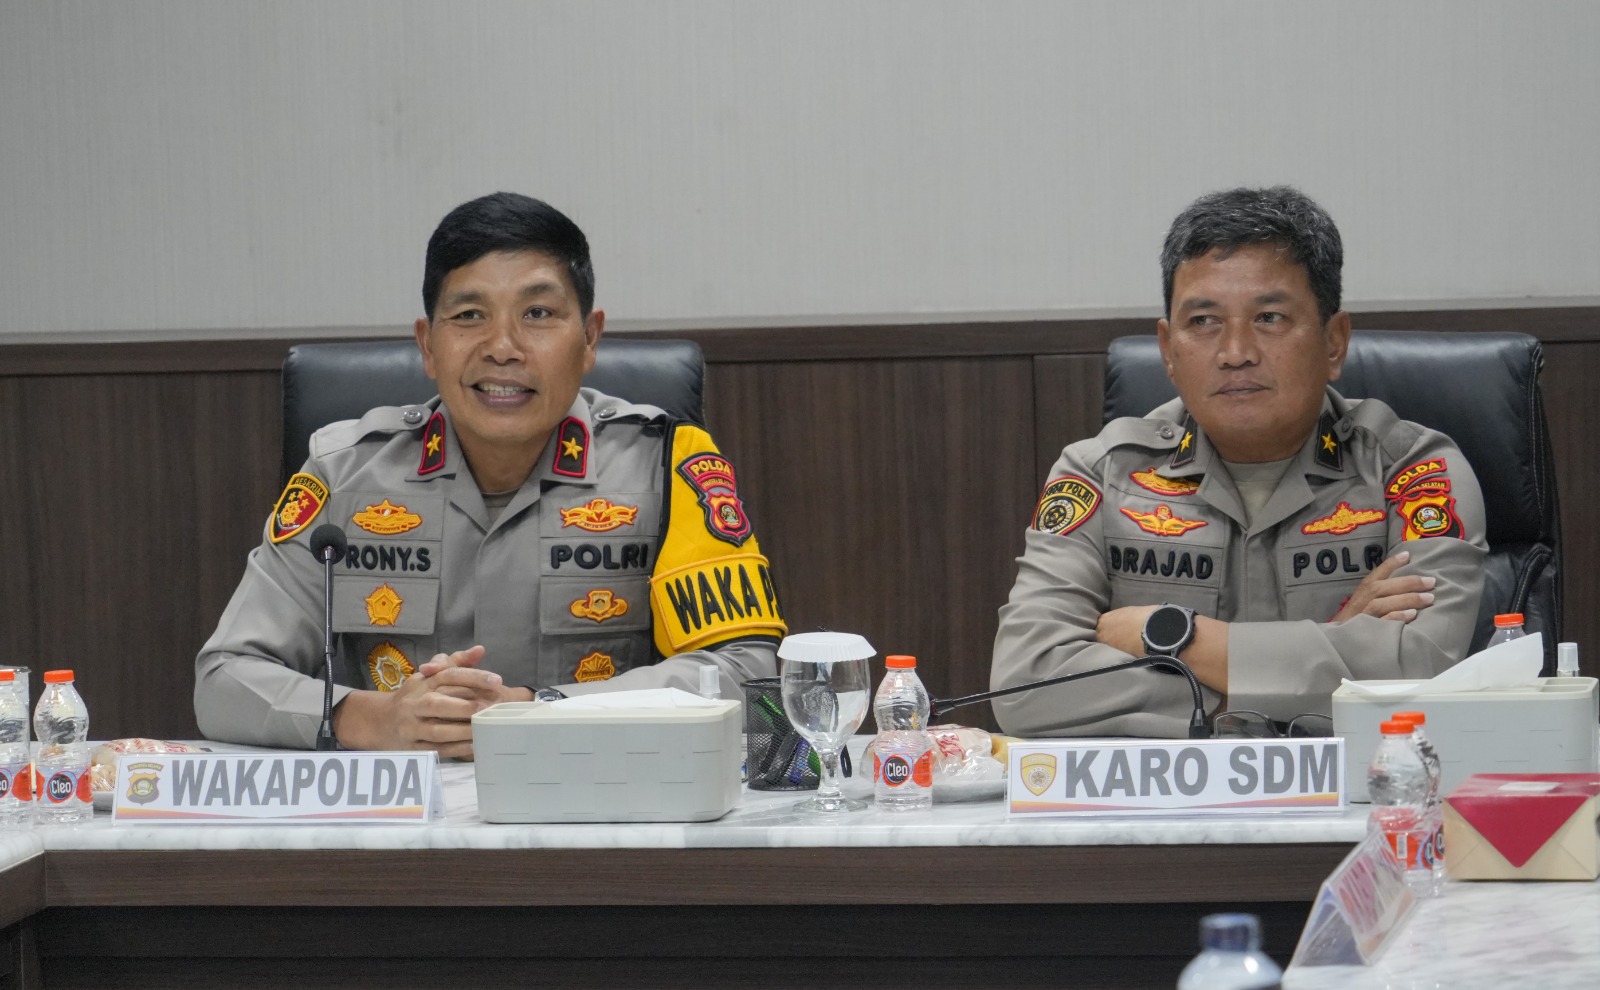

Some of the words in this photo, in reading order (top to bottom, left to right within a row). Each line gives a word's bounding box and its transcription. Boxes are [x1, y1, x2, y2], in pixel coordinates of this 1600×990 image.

[690, 459, 732, 476] POLDA
[1389, 462, 1441, 494] POLDA
[294, 477, 324, 498] RESKRIM
[346, 544, 431, 572] RONY.S
[550, 543, 648, 570] POLRI
[1110, 545, 1213, 580] DRAJAD
[1293, 544, 1384, 578] POLR
[172, 758, 423, 807] WAKAPOLDA
[887, 762, 908, 777] Cleo
[1065, 747, 1209, 799] KARO
[1228, 744, 1338, 796] SDM
[51, 779, 71, 794] Cleo
